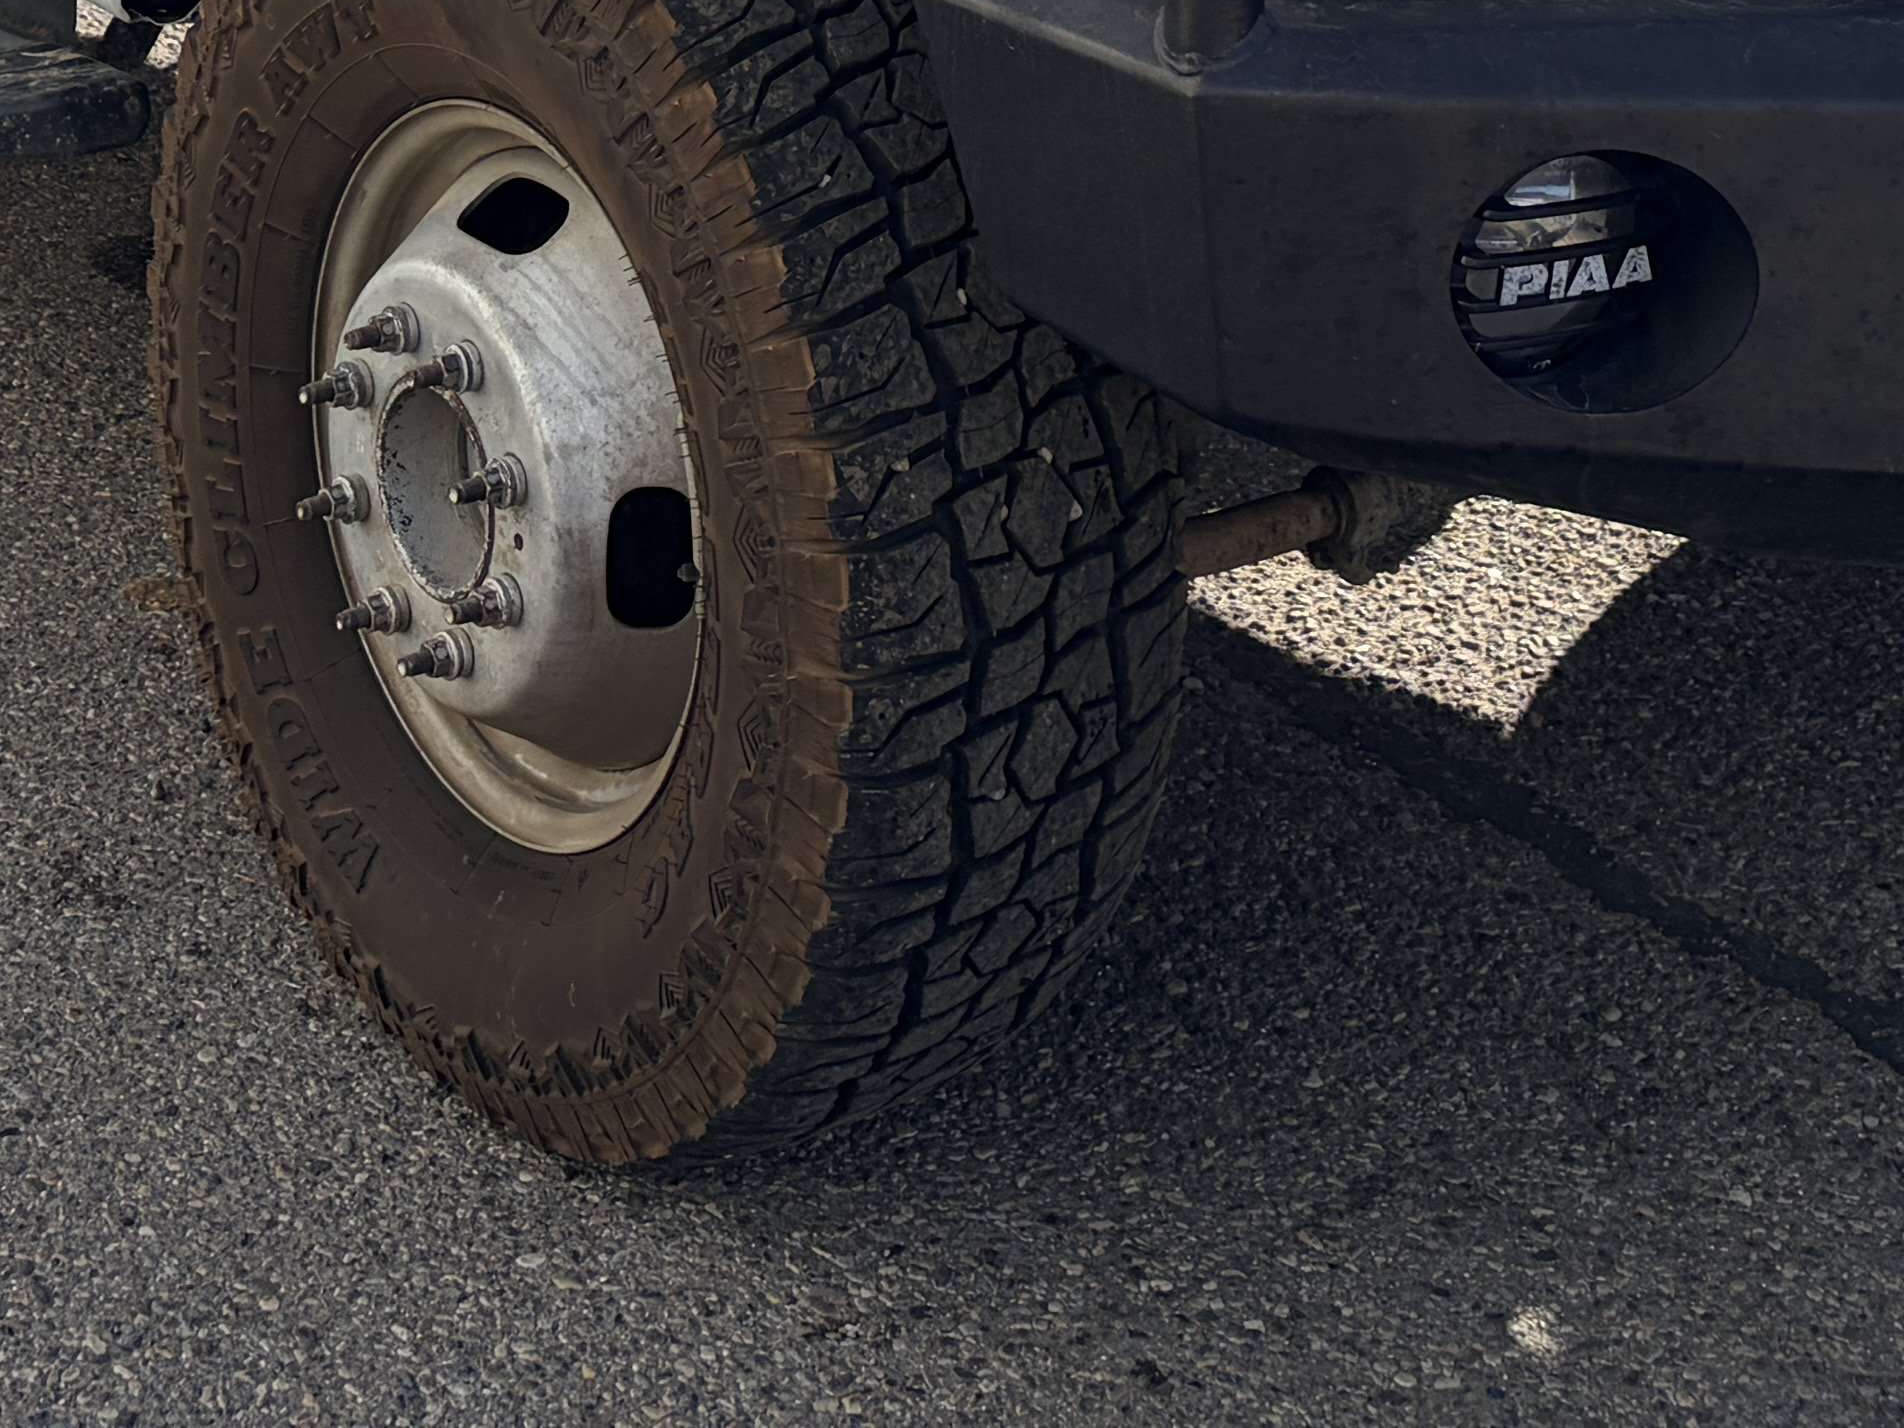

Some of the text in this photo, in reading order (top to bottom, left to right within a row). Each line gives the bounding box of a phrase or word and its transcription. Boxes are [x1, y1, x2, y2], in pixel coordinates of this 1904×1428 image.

[194, 106, 275, 597] CLIMBER
[1498, 244, 1654, 307] PIAA
[237, 624, 380, 895] WIDE
